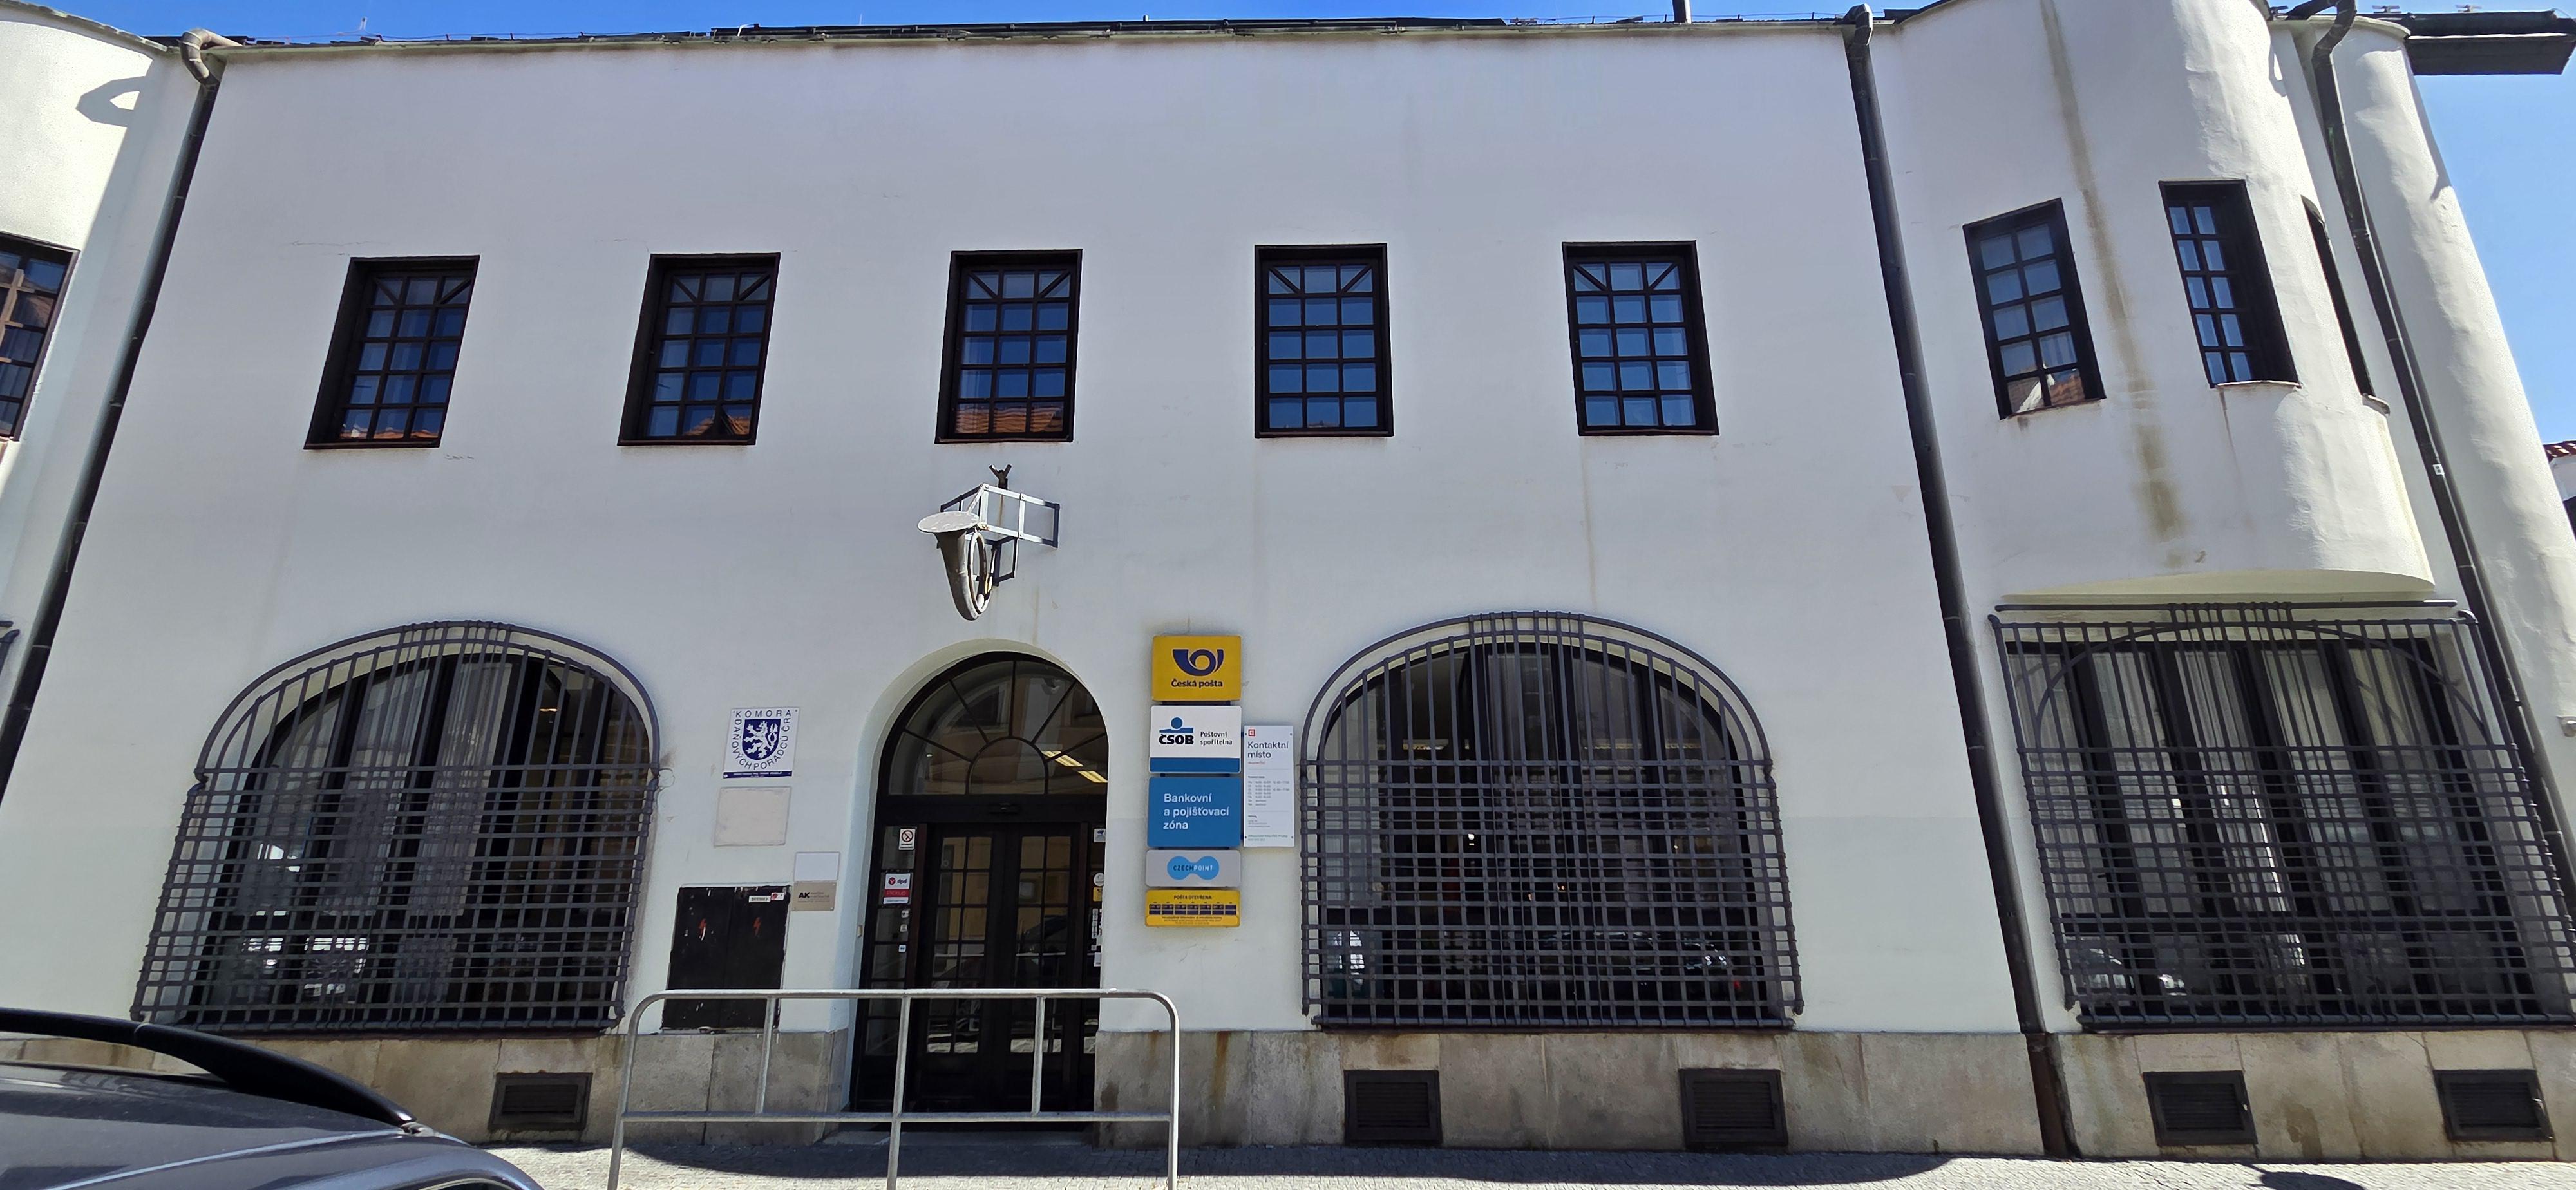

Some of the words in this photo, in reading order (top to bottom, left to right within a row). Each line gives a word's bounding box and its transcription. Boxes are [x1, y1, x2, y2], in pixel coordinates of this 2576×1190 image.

[1171, 678, 1197, 688] Česká
[1198, 679, 1223, 688] pošta
[735, 710, 791, 719] KOMORA
[731, 718, 752, 770] DAŇOVÝCH
[1159, 733, 1194, 745] ČSOB
[1247, 741, 1289, 750] Kontaktní
[1247, 750, 1272, 759] místo
[1164, 793, 1212, 803] Bankovní
[1173, 806, 1230, 818] pojišťovací
[1162, 820, 1189, 830] zóna
